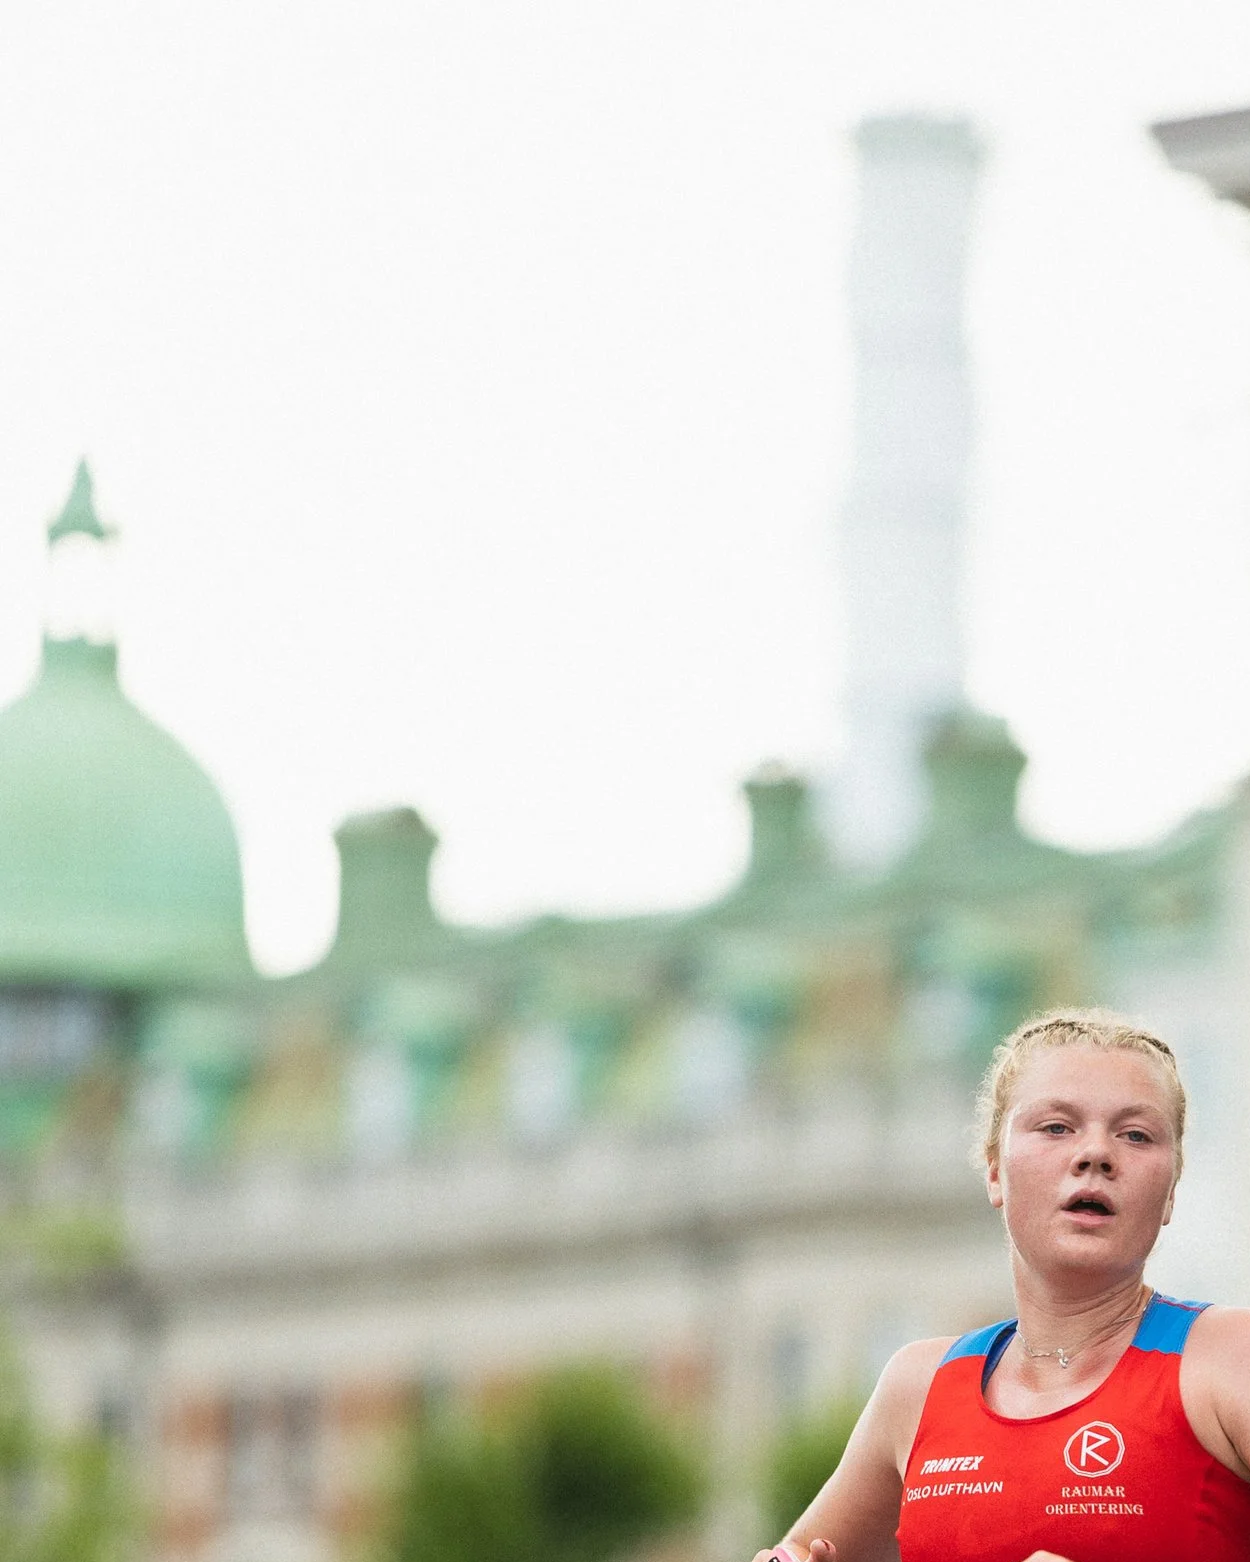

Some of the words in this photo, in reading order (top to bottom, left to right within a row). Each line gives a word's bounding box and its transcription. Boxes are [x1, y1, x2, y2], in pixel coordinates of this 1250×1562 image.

[920, 1455, 984, 1475] TRIMTEX
[907, 1485, 931, 1502] OSLO
[932, 1481, 1003, 1497] LUFTHAVN
[1061, 1485, 1126, 1498] RAUMAR
[1045, 1503, 1144, 1515] ORIENTERING
